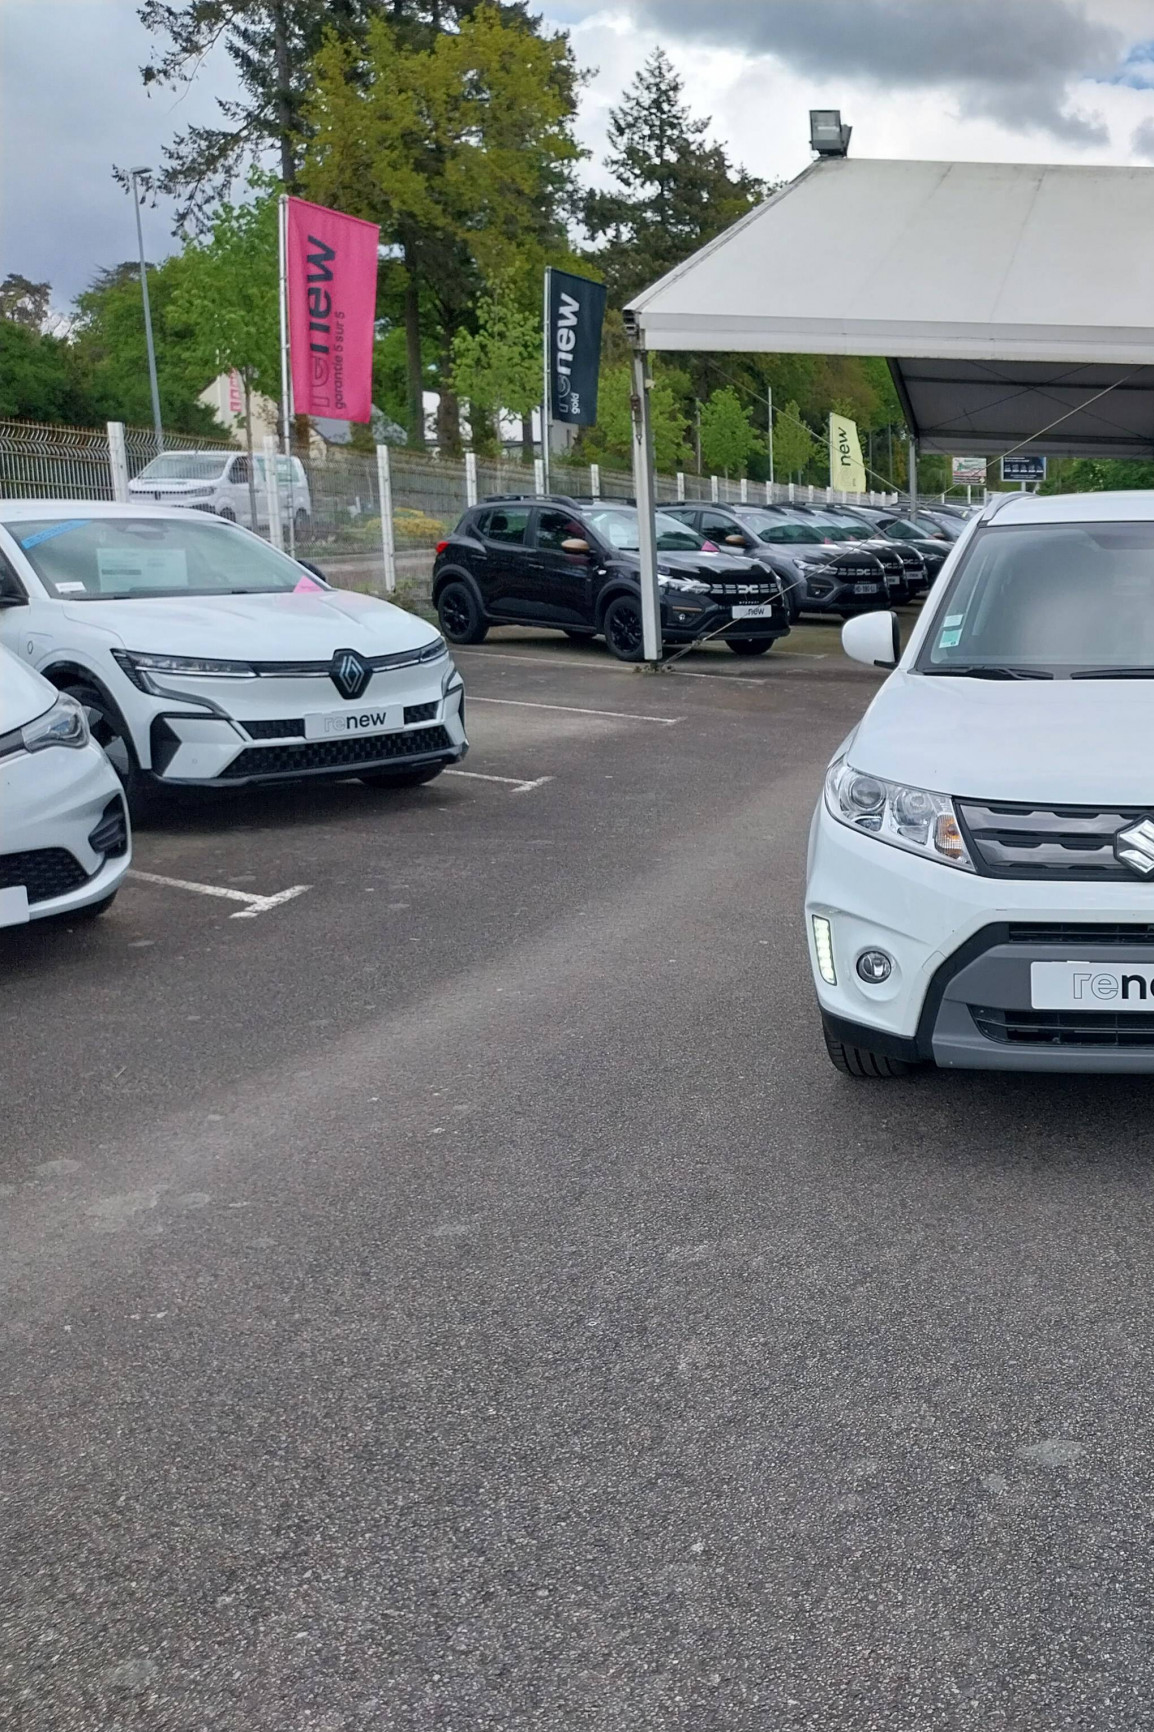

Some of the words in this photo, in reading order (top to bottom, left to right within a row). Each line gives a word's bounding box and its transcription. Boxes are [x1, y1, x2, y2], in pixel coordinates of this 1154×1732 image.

[306, 235, 336, 407] renew
[334, 321, 345, 342] sur
[556, 292, 580, 413] renew
[332, 355, 346, 409] garantie
[571, 392, 580, 414] gold
[838, 426, 851, 487] new
[324, 712, 386, 732] renew
